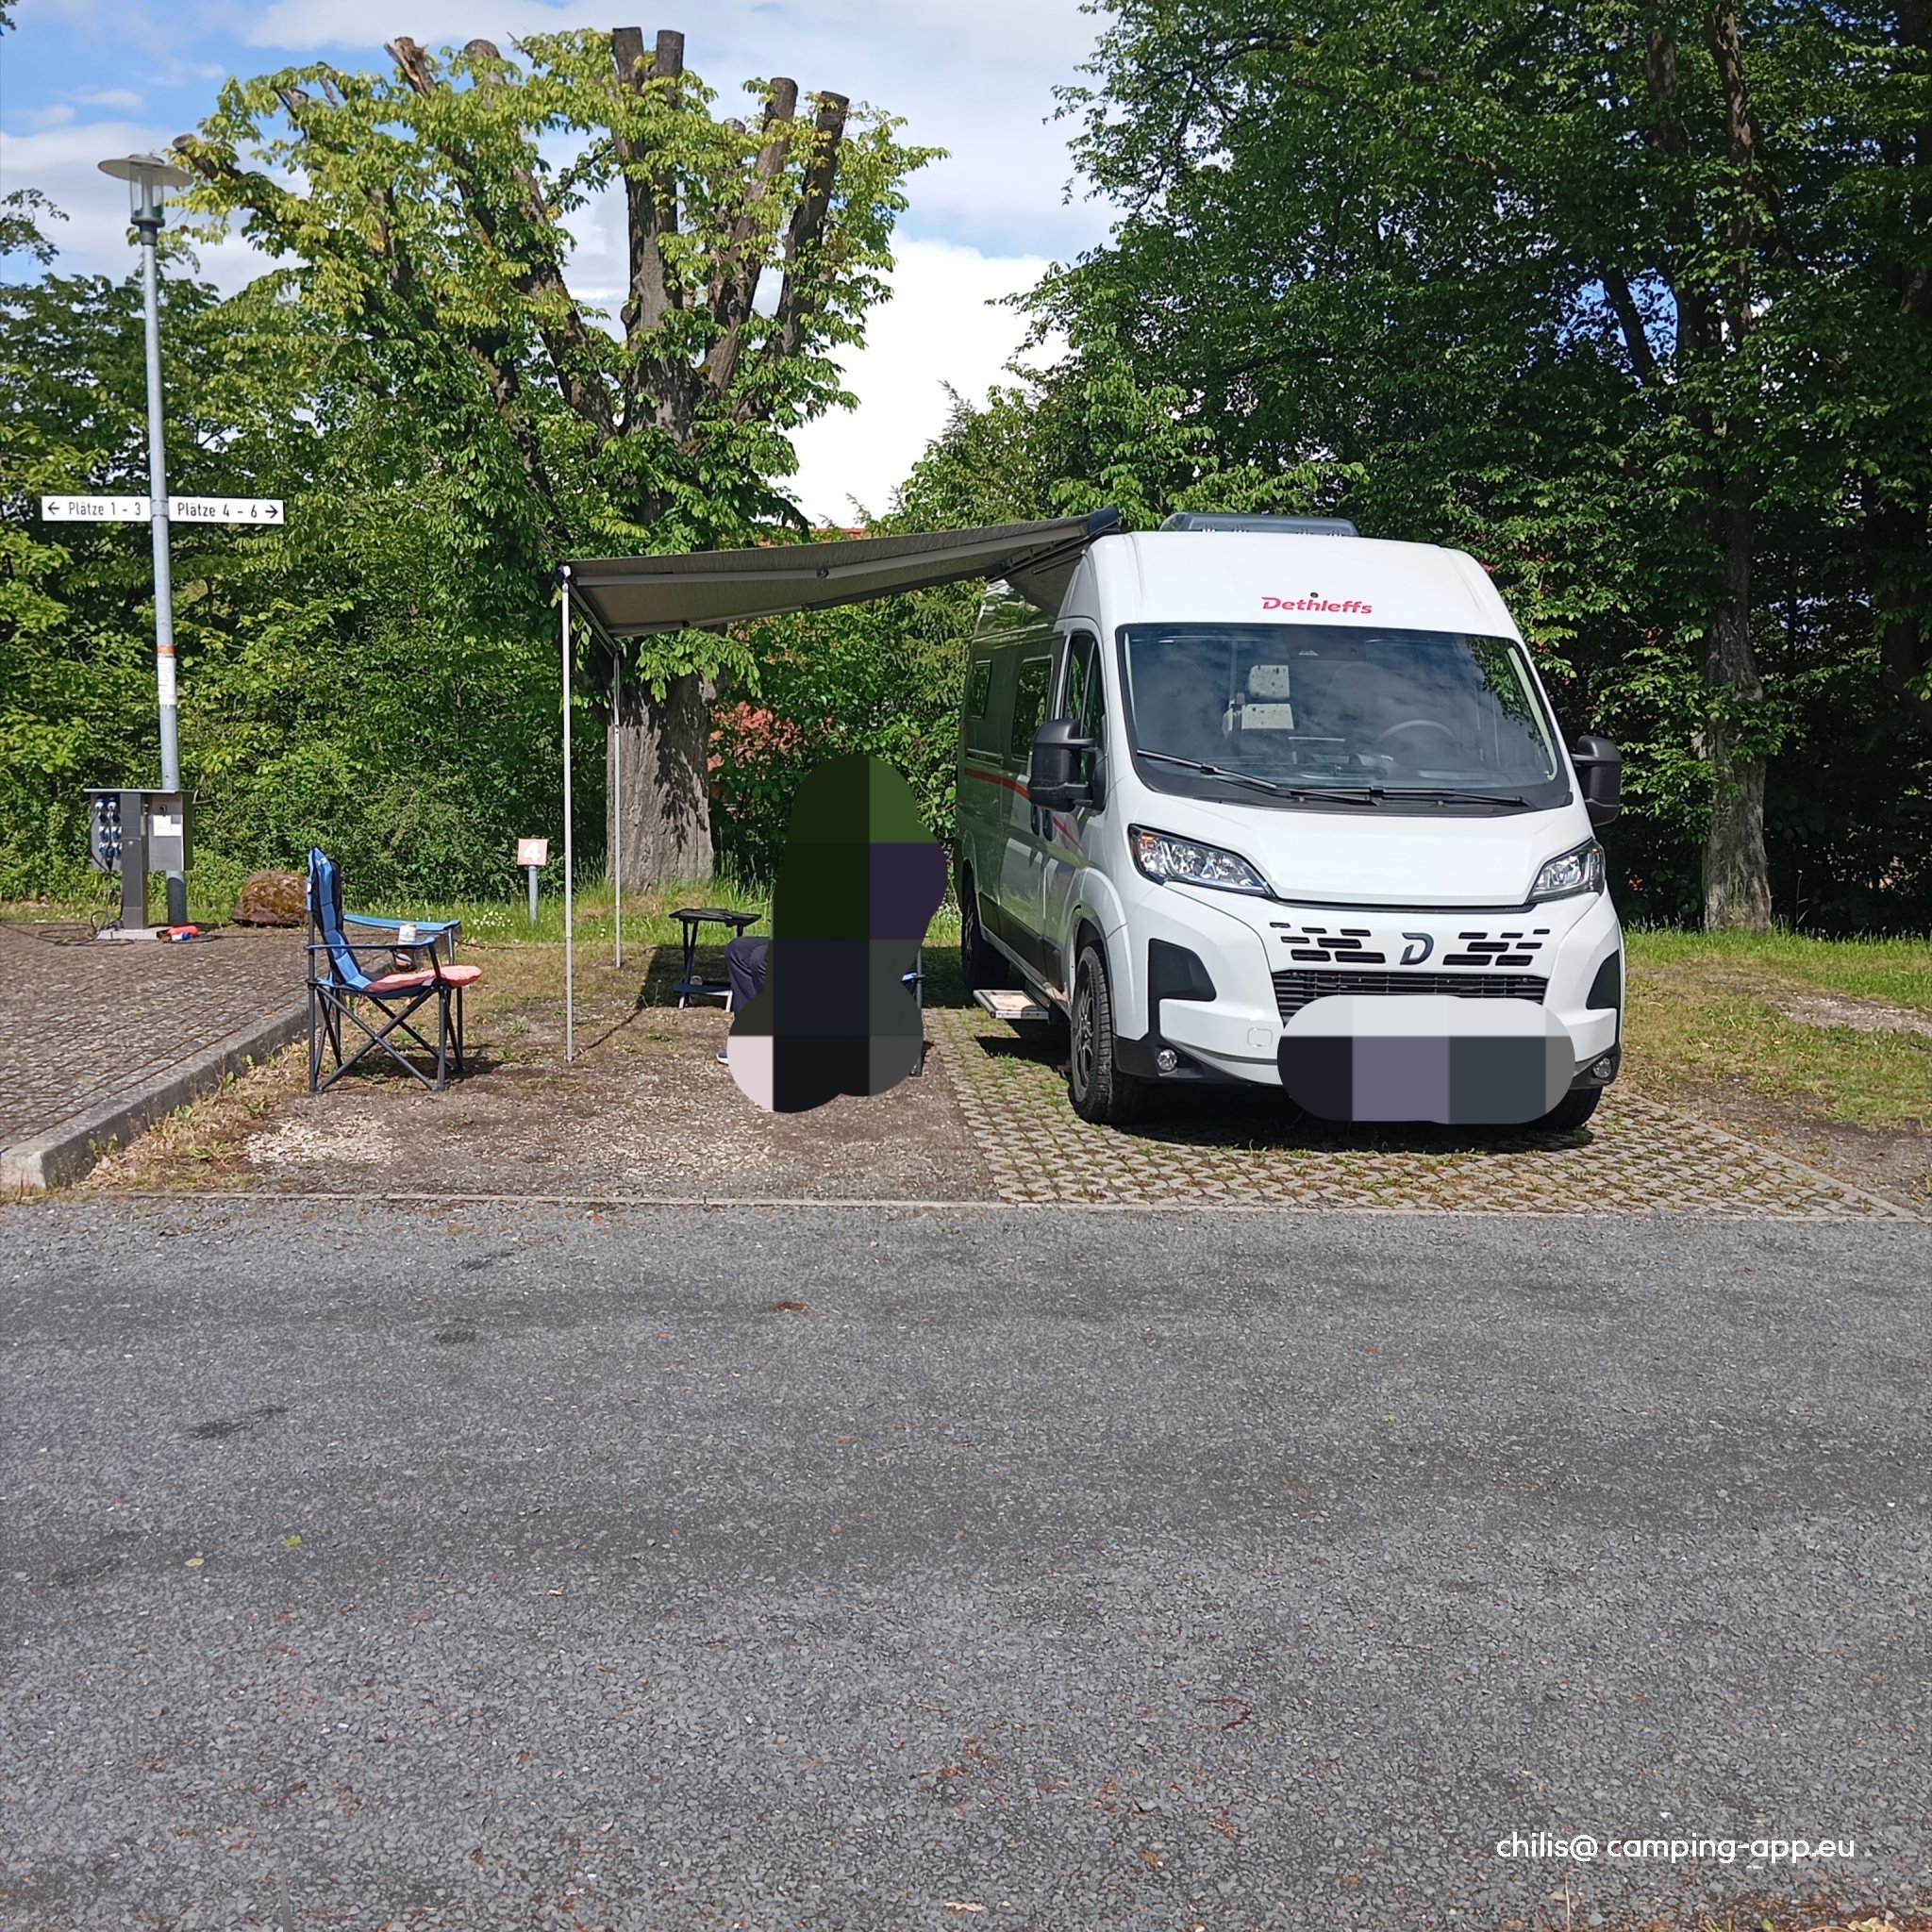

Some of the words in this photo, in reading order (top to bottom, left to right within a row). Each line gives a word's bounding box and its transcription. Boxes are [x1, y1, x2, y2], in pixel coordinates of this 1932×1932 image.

[68, 501, 104, 516] Plätze
[110, 502, 116, 516] 1
[134, 502, 142, 516] 3
[177, 502, 216, 518] Plätze
[223, 504, 230, 517] 4
[250, 505, 258, 518] 6
[1261, 596, 1373, 614] Dethleffs
[523, 841, 541, 862] 4
[1399, 932, 1434, 966] D
